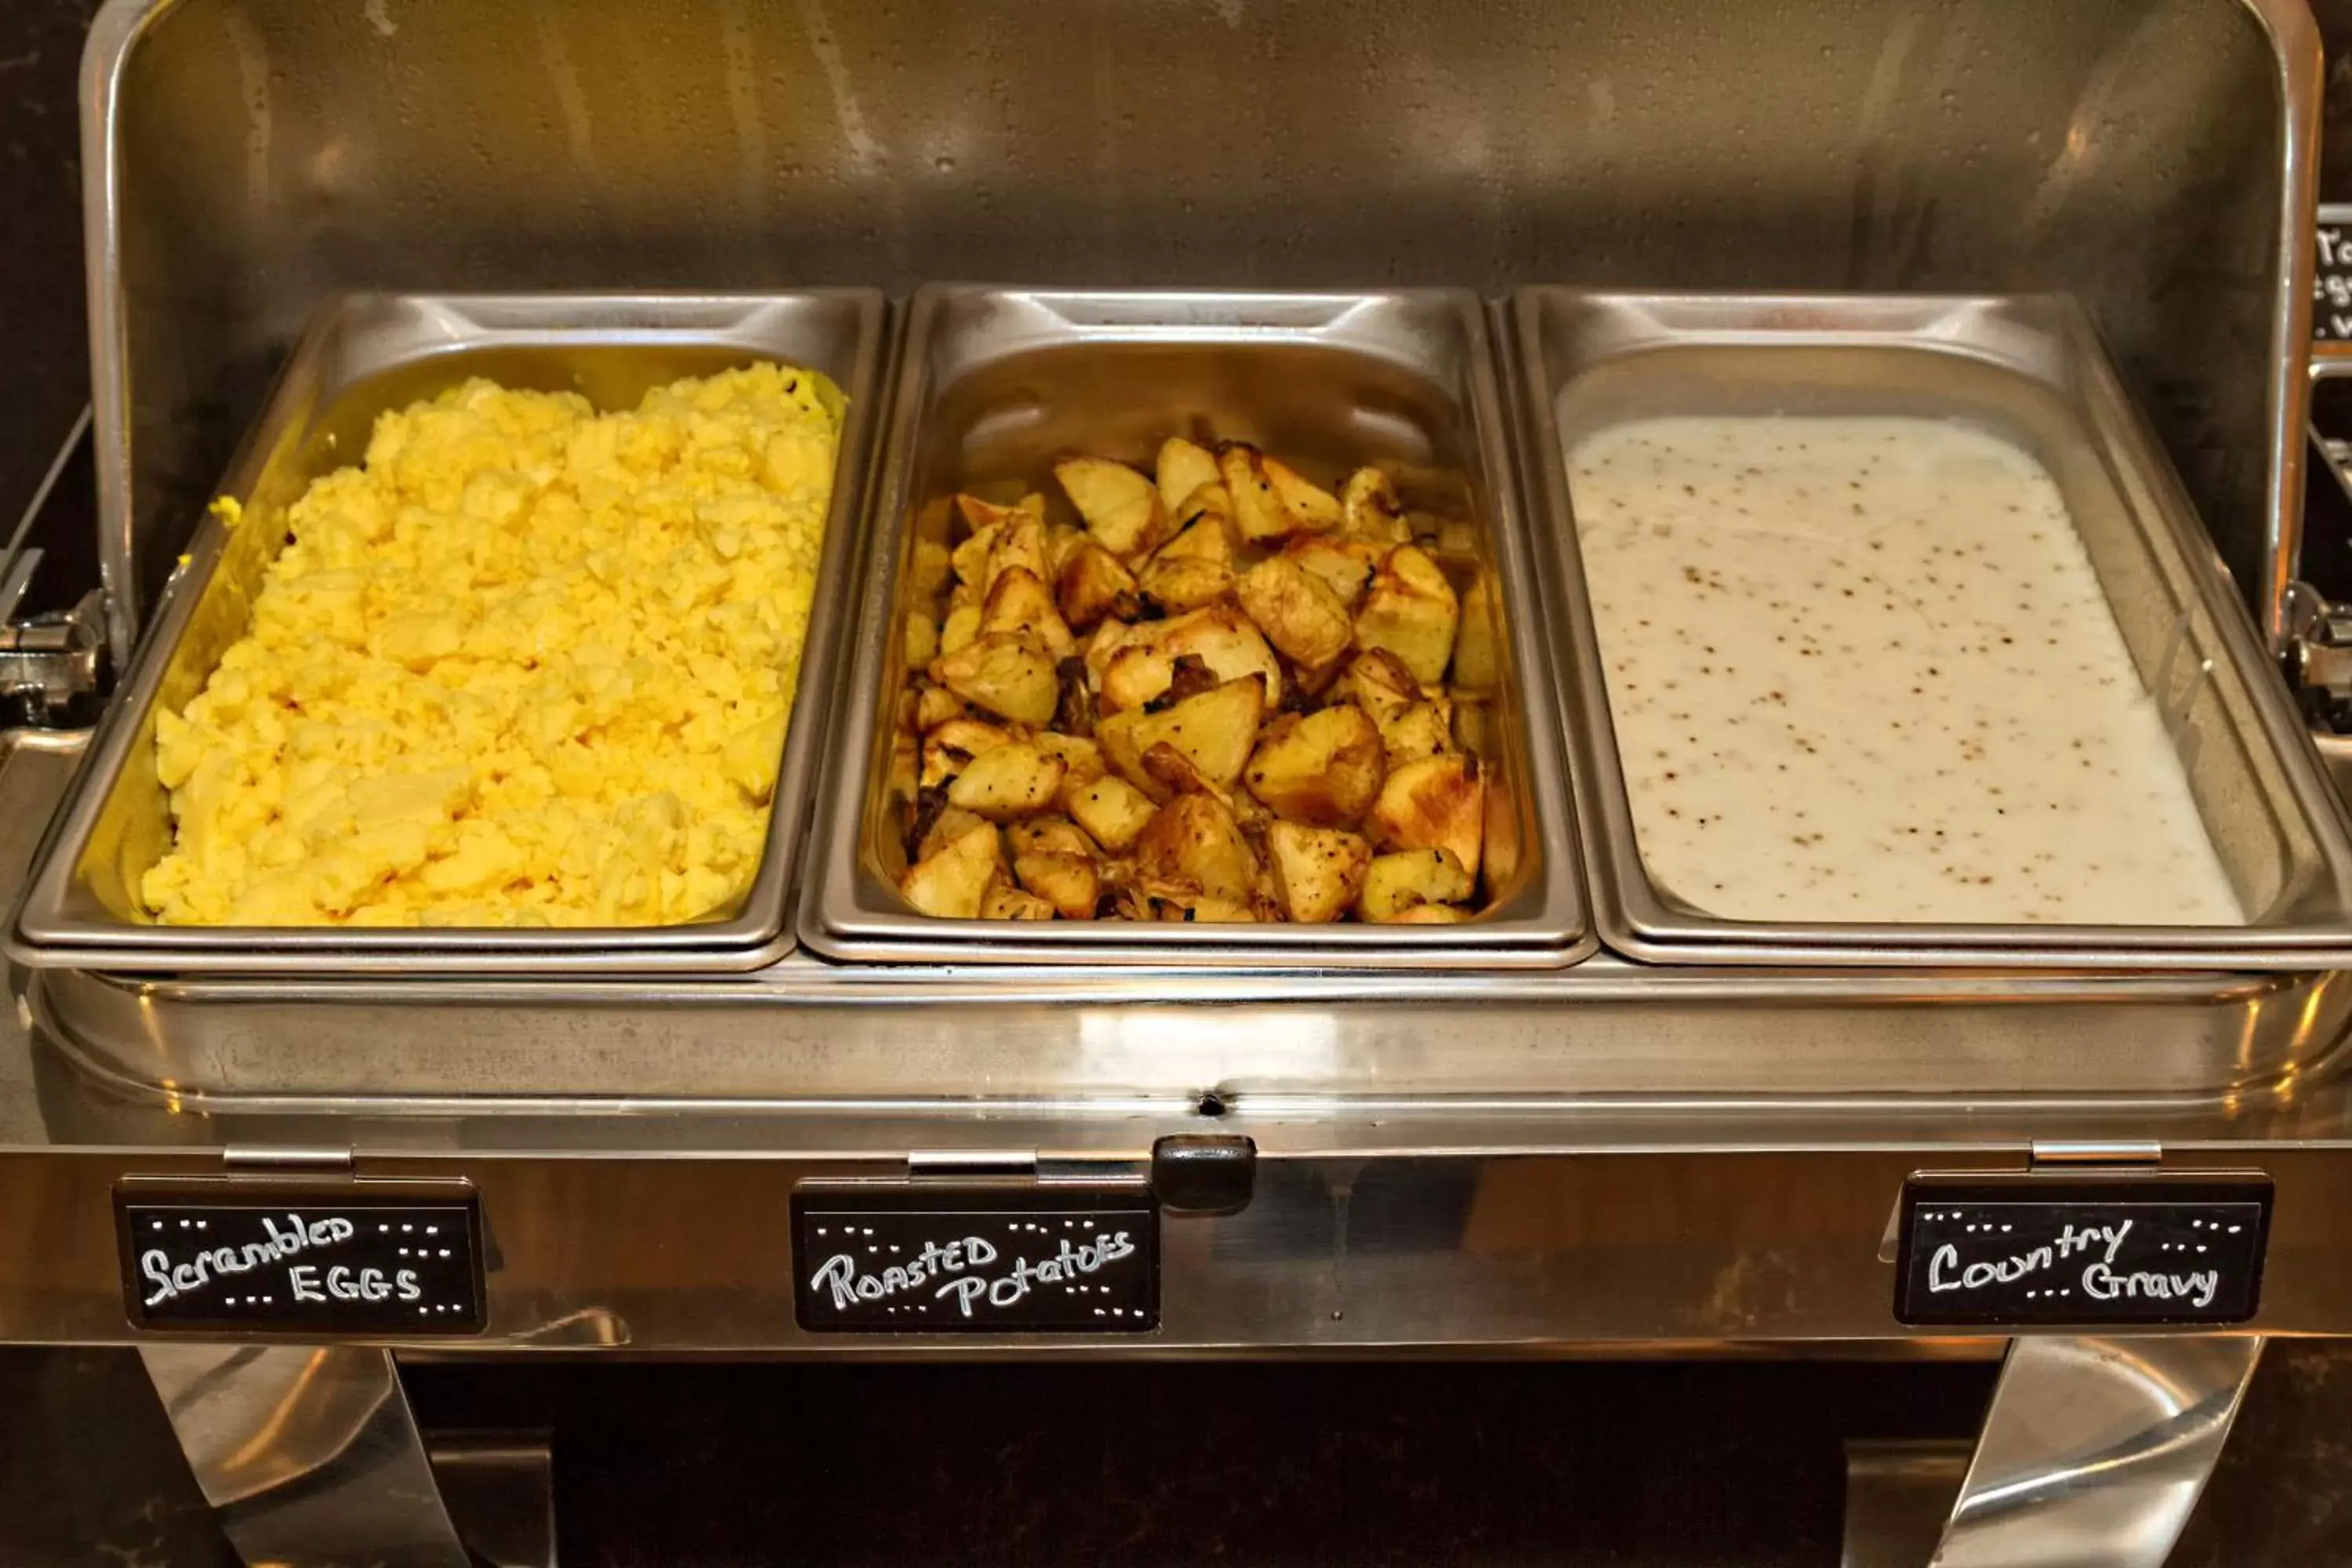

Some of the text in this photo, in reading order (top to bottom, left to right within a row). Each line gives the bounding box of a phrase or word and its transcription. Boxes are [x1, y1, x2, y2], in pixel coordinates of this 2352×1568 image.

[1929, 1219, 2132, 1292] Country
[289, 1266, 420, 1301] EGGS
[2082, 1263, 2218, 1307] Gravy
